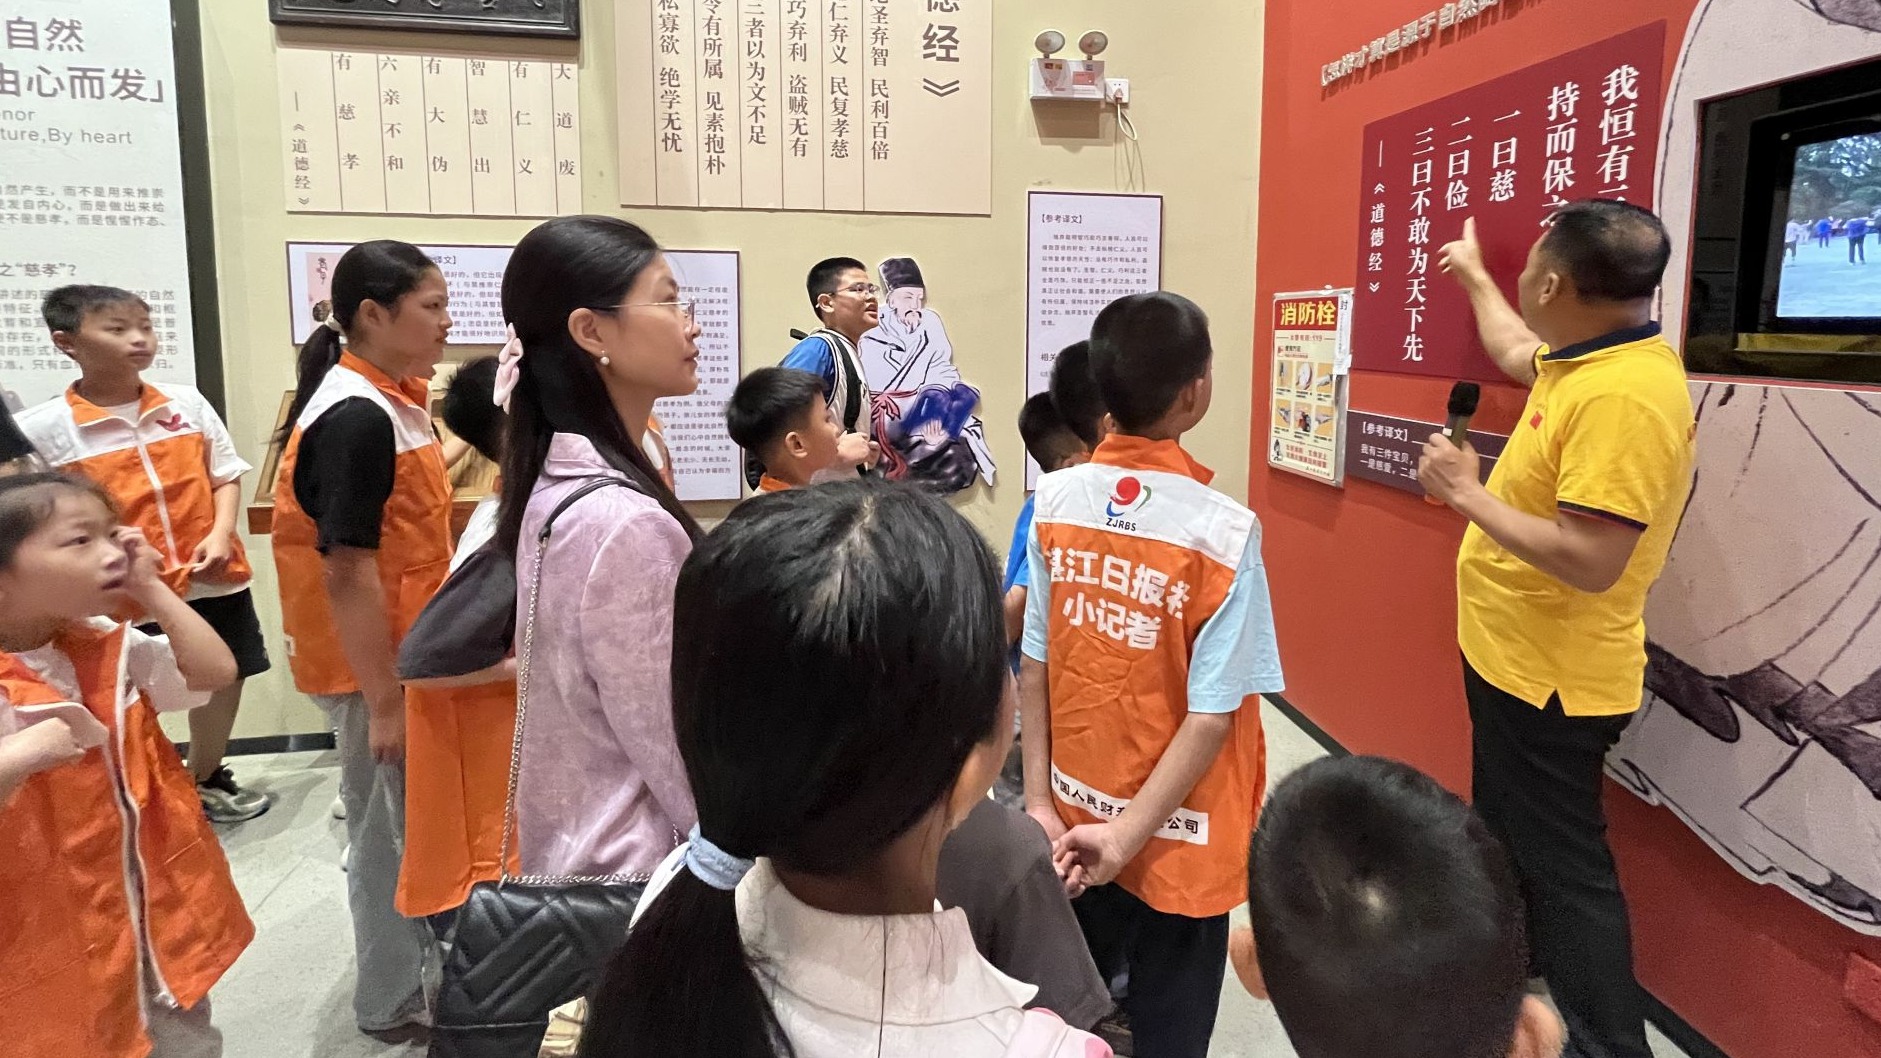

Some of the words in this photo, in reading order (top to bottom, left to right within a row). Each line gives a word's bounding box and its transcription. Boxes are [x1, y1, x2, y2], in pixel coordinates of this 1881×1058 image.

[6, 16, 84, 52] 自然
[869, 0, 889, 67] 圣弃智
[0, 109, 35, 121] nor
[81, 128, 132, 144] heart
[335, 53, 360, 171] 有慈孝
[380, 54, 404, 171] 六亲不和
[426, 57, 448, 173] 有大伪
[470, 59, 491, 174] 智慧出
[512, 60, 533, 175] 有仁义
[554, 63, 576, 176] 大道废
[659, 67, 682, 154] 绝学无忧
[704, 91, 726, 175] 见素抱朴
[788, 74, 809, 158] 盗贼无有
[829, 76, 850, 159] 民复孝慈
[870, 78, 890, 160] 民利百倍
[0, 185, 164, 198] 然产生，而不是用来推崇
[1280, 299, 1336, 326] 消防栓
[1106, 517, 1137, 532] ZJRBS
[1062, 591, 1162, 650] 小记者
